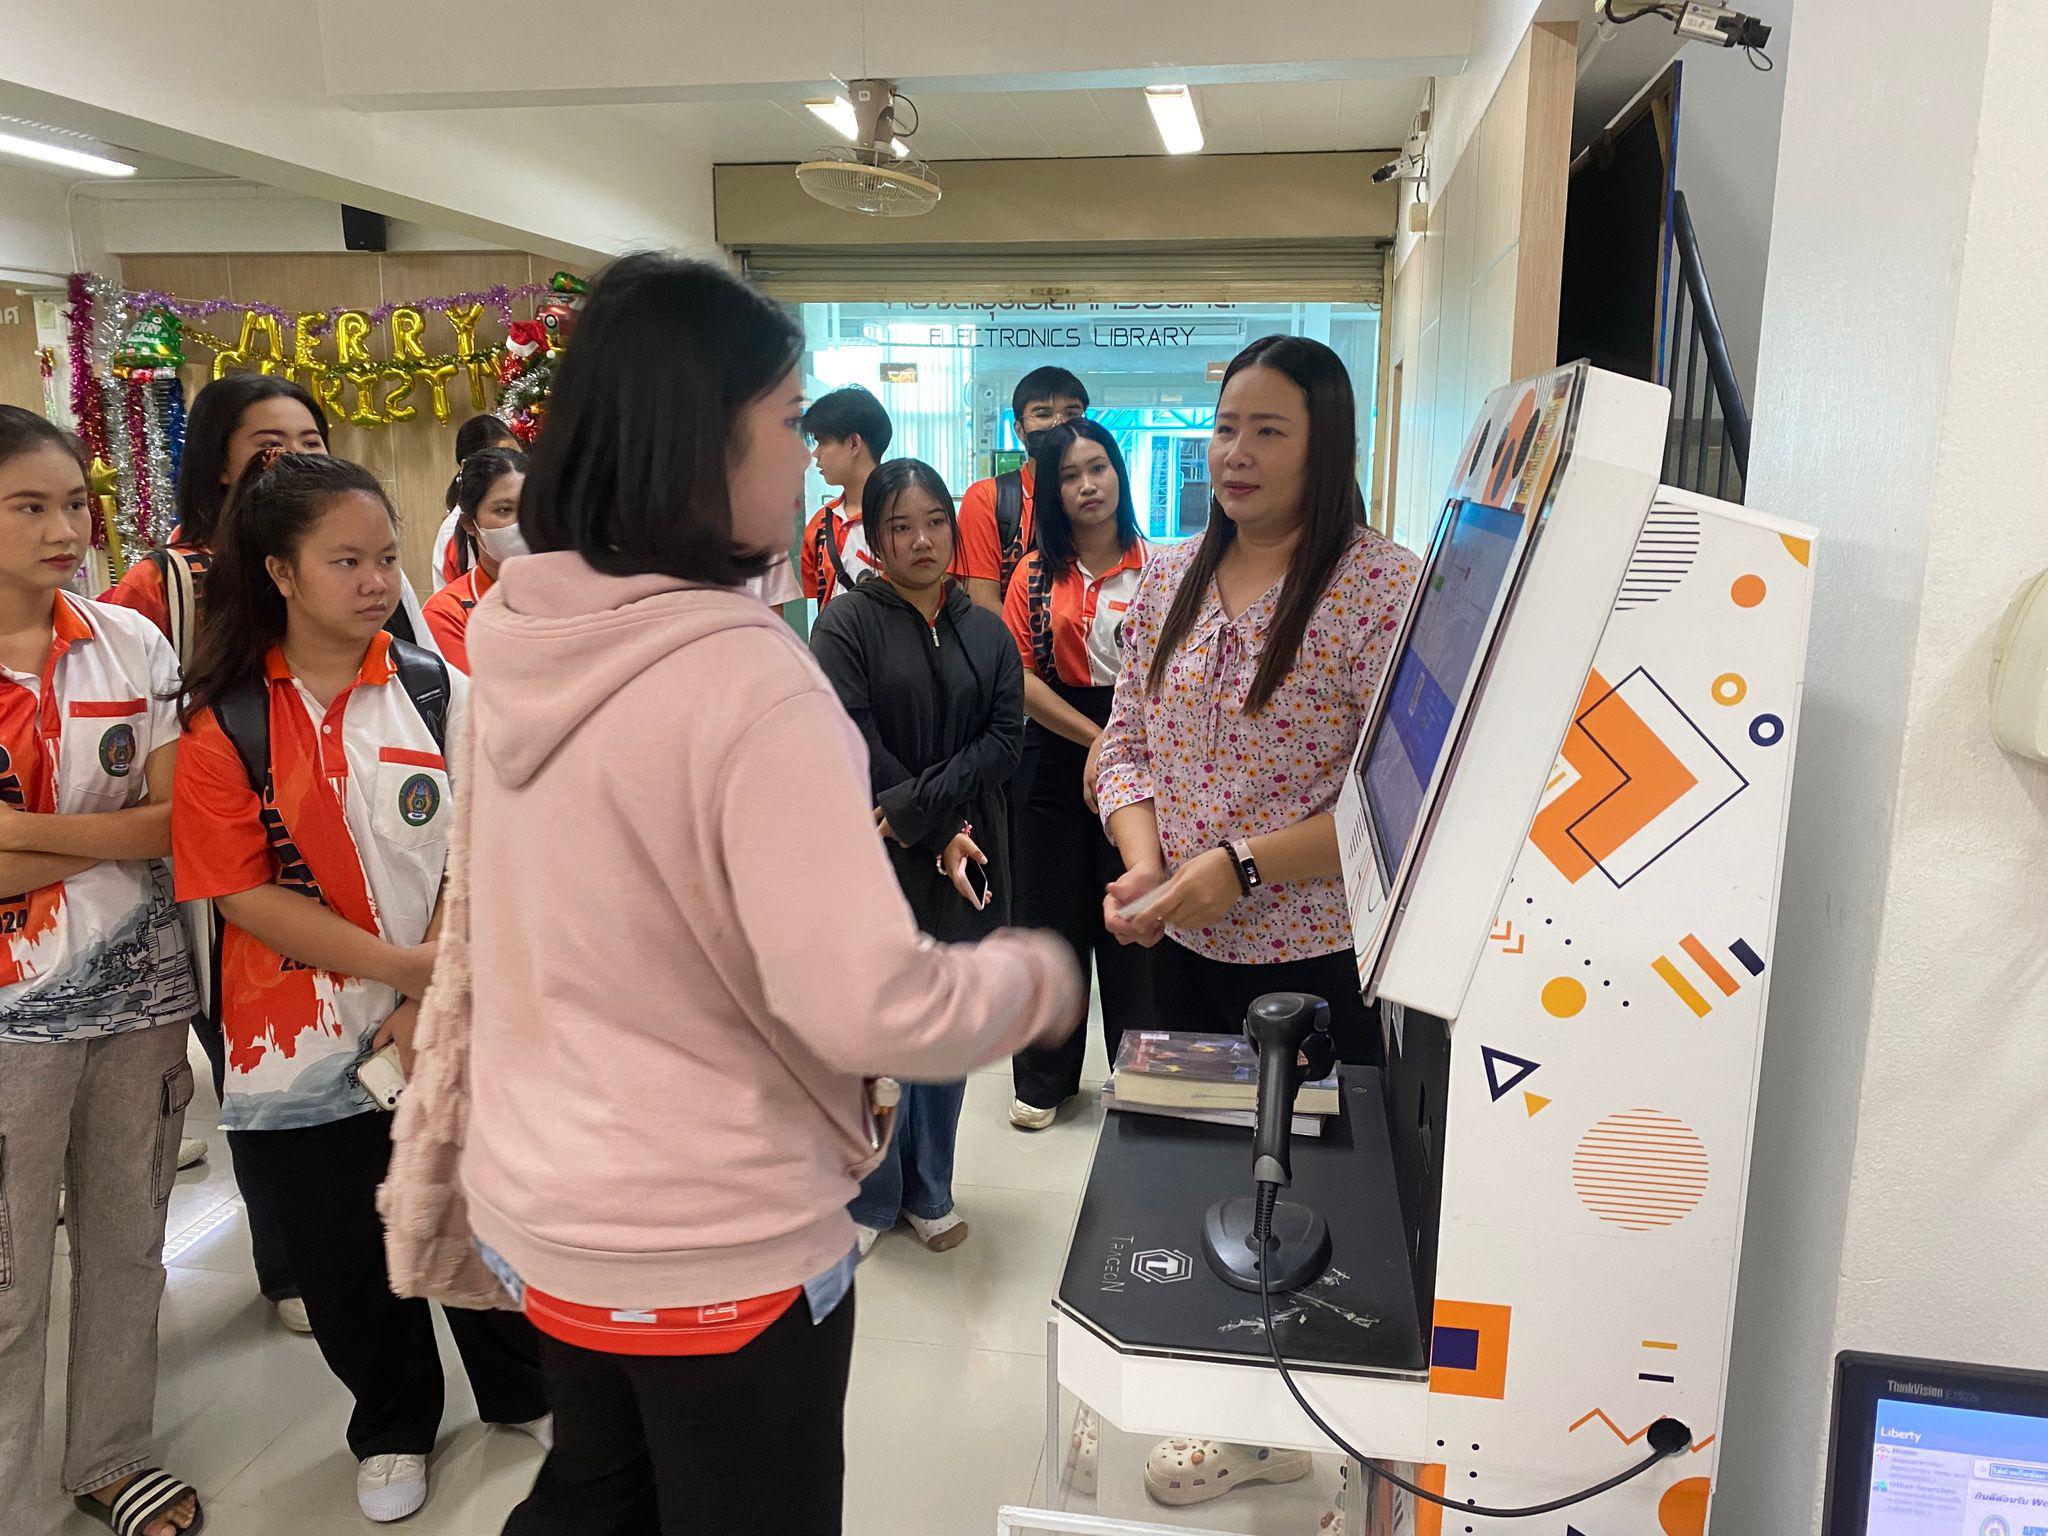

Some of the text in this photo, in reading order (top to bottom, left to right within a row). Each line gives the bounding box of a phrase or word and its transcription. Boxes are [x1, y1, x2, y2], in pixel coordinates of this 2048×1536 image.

[929, 326, 1196, 348] ELECTRONICS LIBRARY
[0, 909, 28, 933] 24
[1888, 1380, 1943, 1398] ThinkVision
[1880, 1426, 1922, 1444] Liberty
